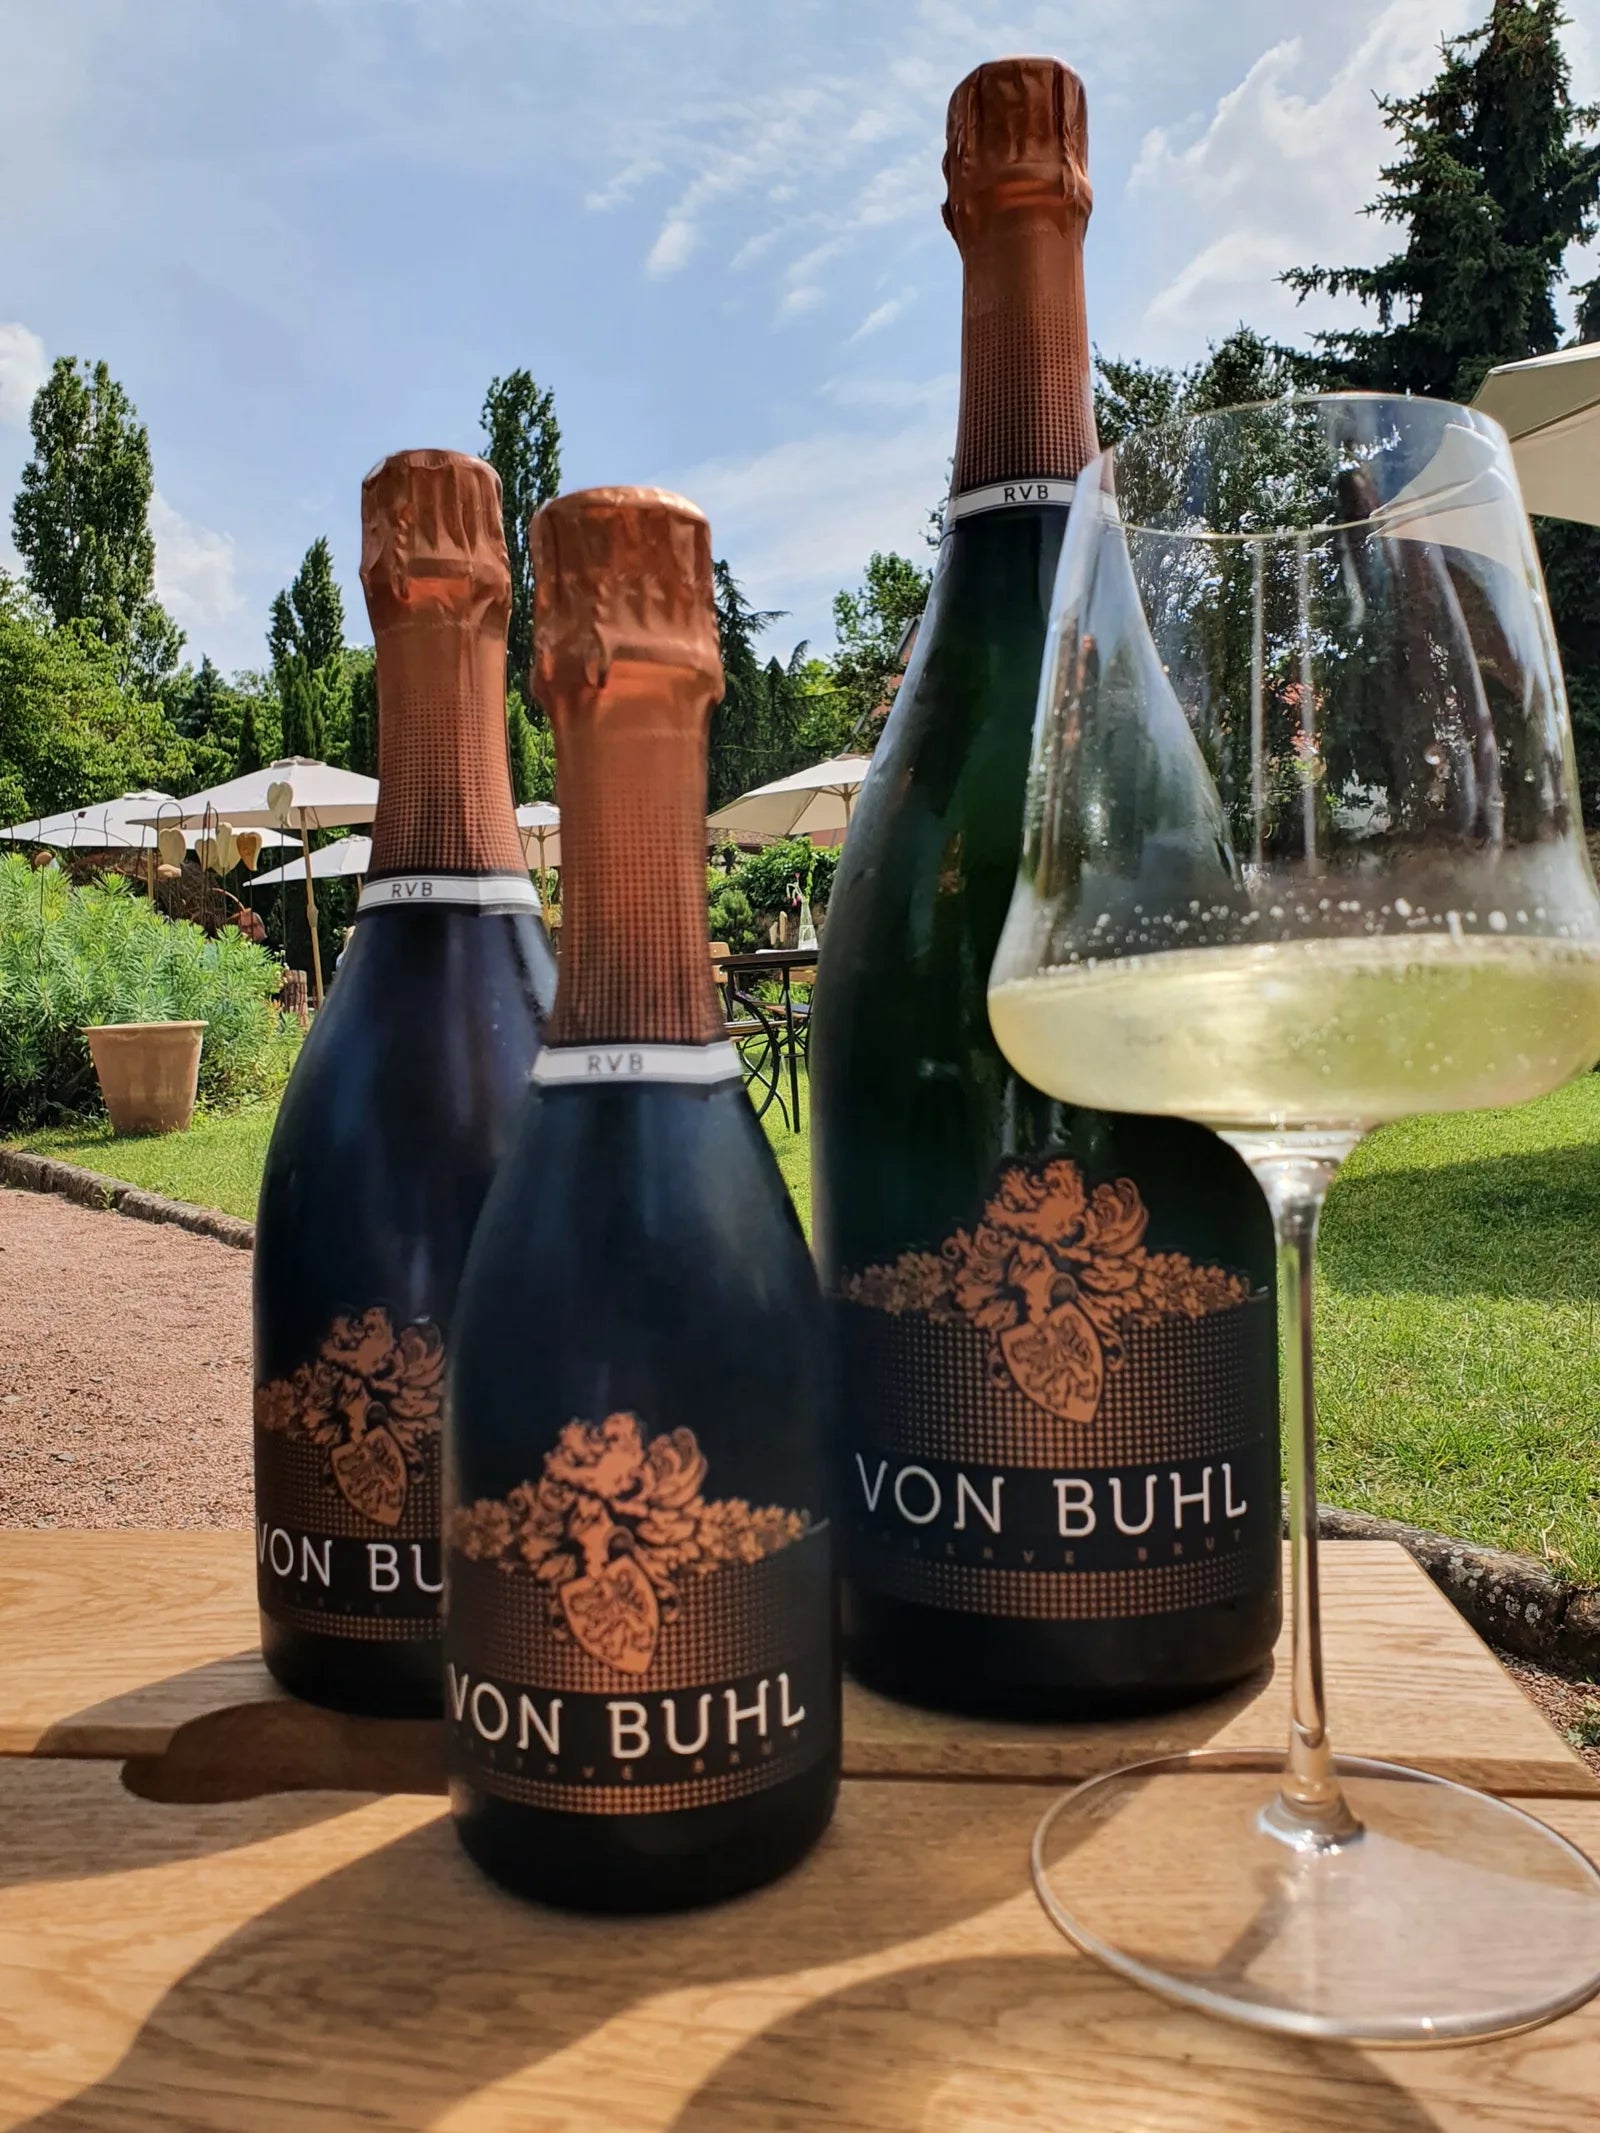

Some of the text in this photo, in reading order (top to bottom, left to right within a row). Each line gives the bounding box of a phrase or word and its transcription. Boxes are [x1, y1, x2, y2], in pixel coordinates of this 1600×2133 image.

[1003, 484, 1049, 502] RVB
[391, 882, 433, 898] RVB
[587, 1052, 644, 1074] RVB
[856, 1452, 1247, 1538] VON BUHL
[257, 1515, 445, 1593] VON BU
[447, 1661, 564, 1755] VON
[606, 1671, 805, 1759] BUHL
